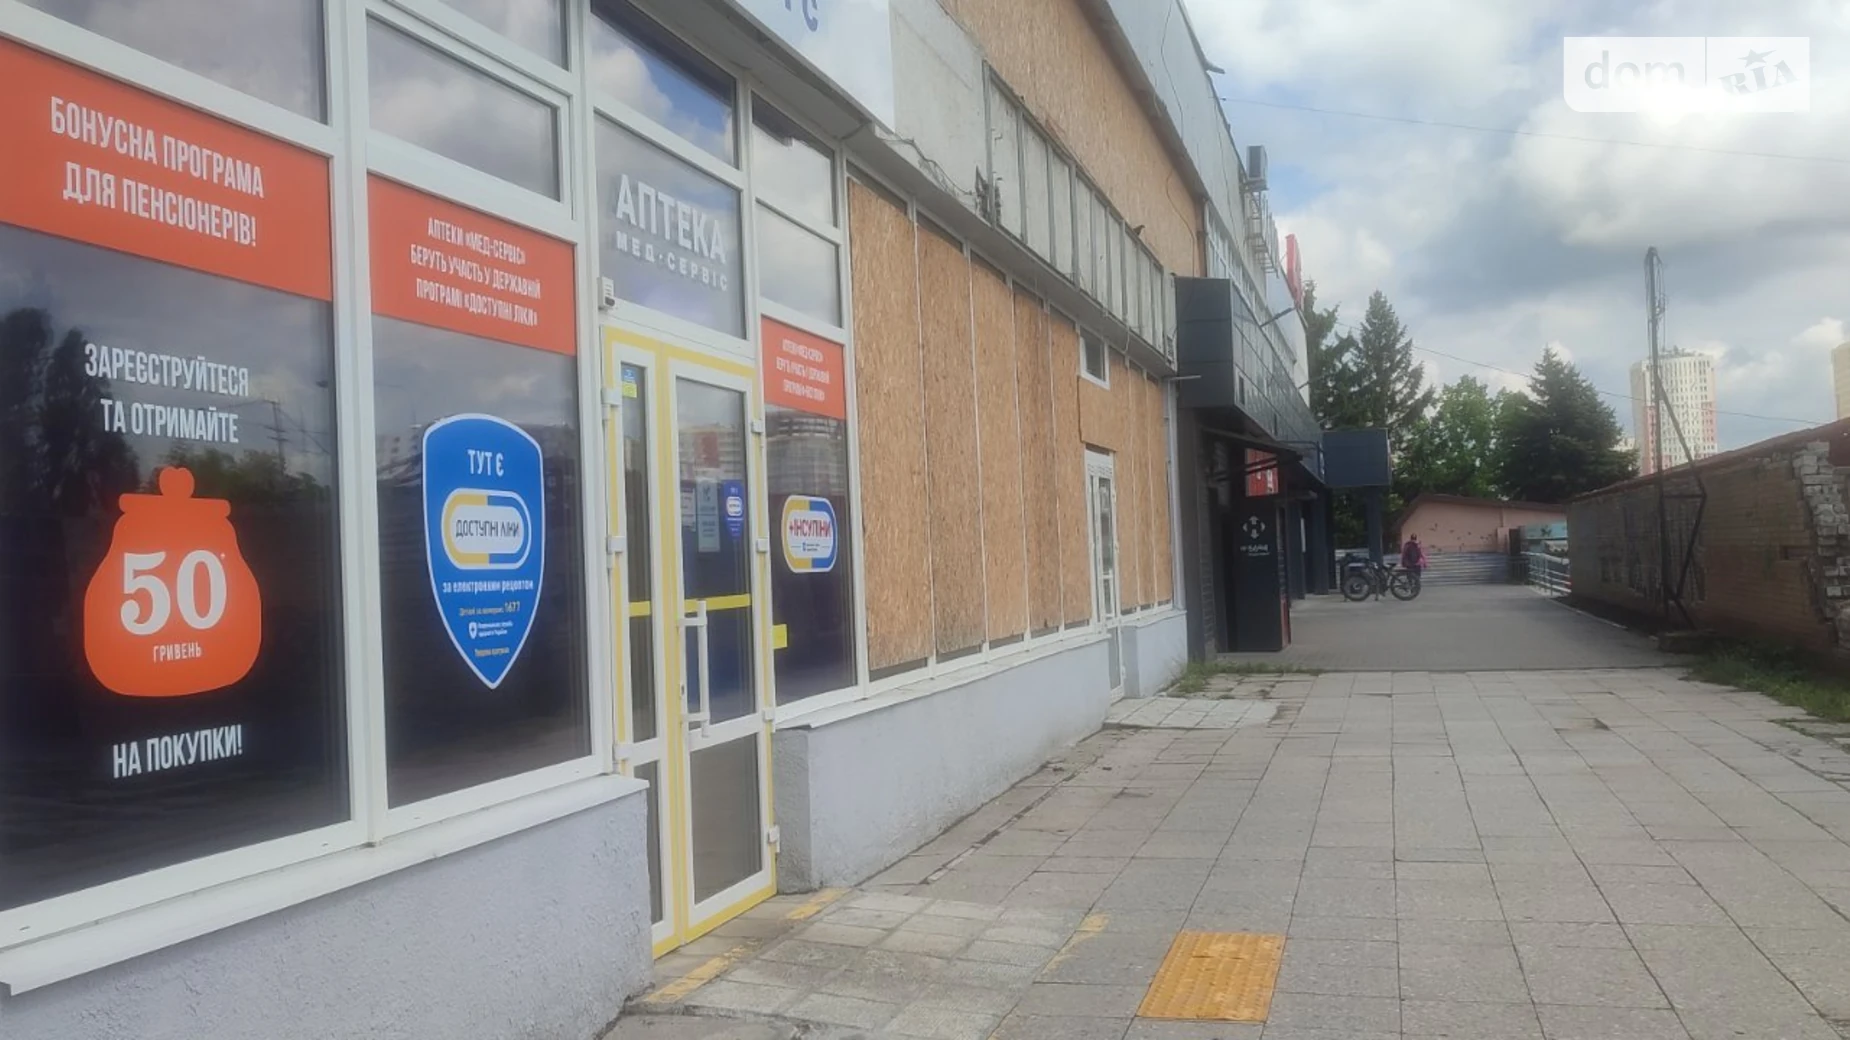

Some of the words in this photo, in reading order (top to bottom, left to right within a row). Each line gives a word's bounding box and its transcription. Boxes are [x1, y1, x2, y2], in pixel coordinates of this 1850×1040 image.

[51, 96, 158, 165] БОНУСНА
[163, 134, 264, 198] ПРОГРАМА
[63, 161, 116, 208] ДЛЯ
[122, 178, 256, 247] ПЕНСІОНЕРІВ!
[616, 173, 726, 264] АПТЕКА
[428, 217, 464, 246] АПТЕКИ
[411, 244, 447, 272] БЕРУТЬ
[448, 256, 483, 283] УЧАСТЬ
[484, 266, 492, 285] У
[492, 269, 541, 299] ДЕРЖАВНІЙ
[416, 278, 462, 308] ПРОГРАМІ
[85, 343, 249, 397] ЗАРЕЄСТРУЙТЕСЯ
[101, 398, 126, 433] ТА
[131, 402, 239, 443] ОТРИМАЙТЕ
[467, 449, 493, 476] ТУТ
[496, 453, 504, 477] Є
[455, 519, 498, 538] ДОСТУПНІ
[500, 521, 520, 538] ЛІКИ
[153, 642, 203, 663] ГРИВЕНЬ
[113, 741, 142, 779] НА
[146, 724, 243, 773] ПОКУПКИ!
